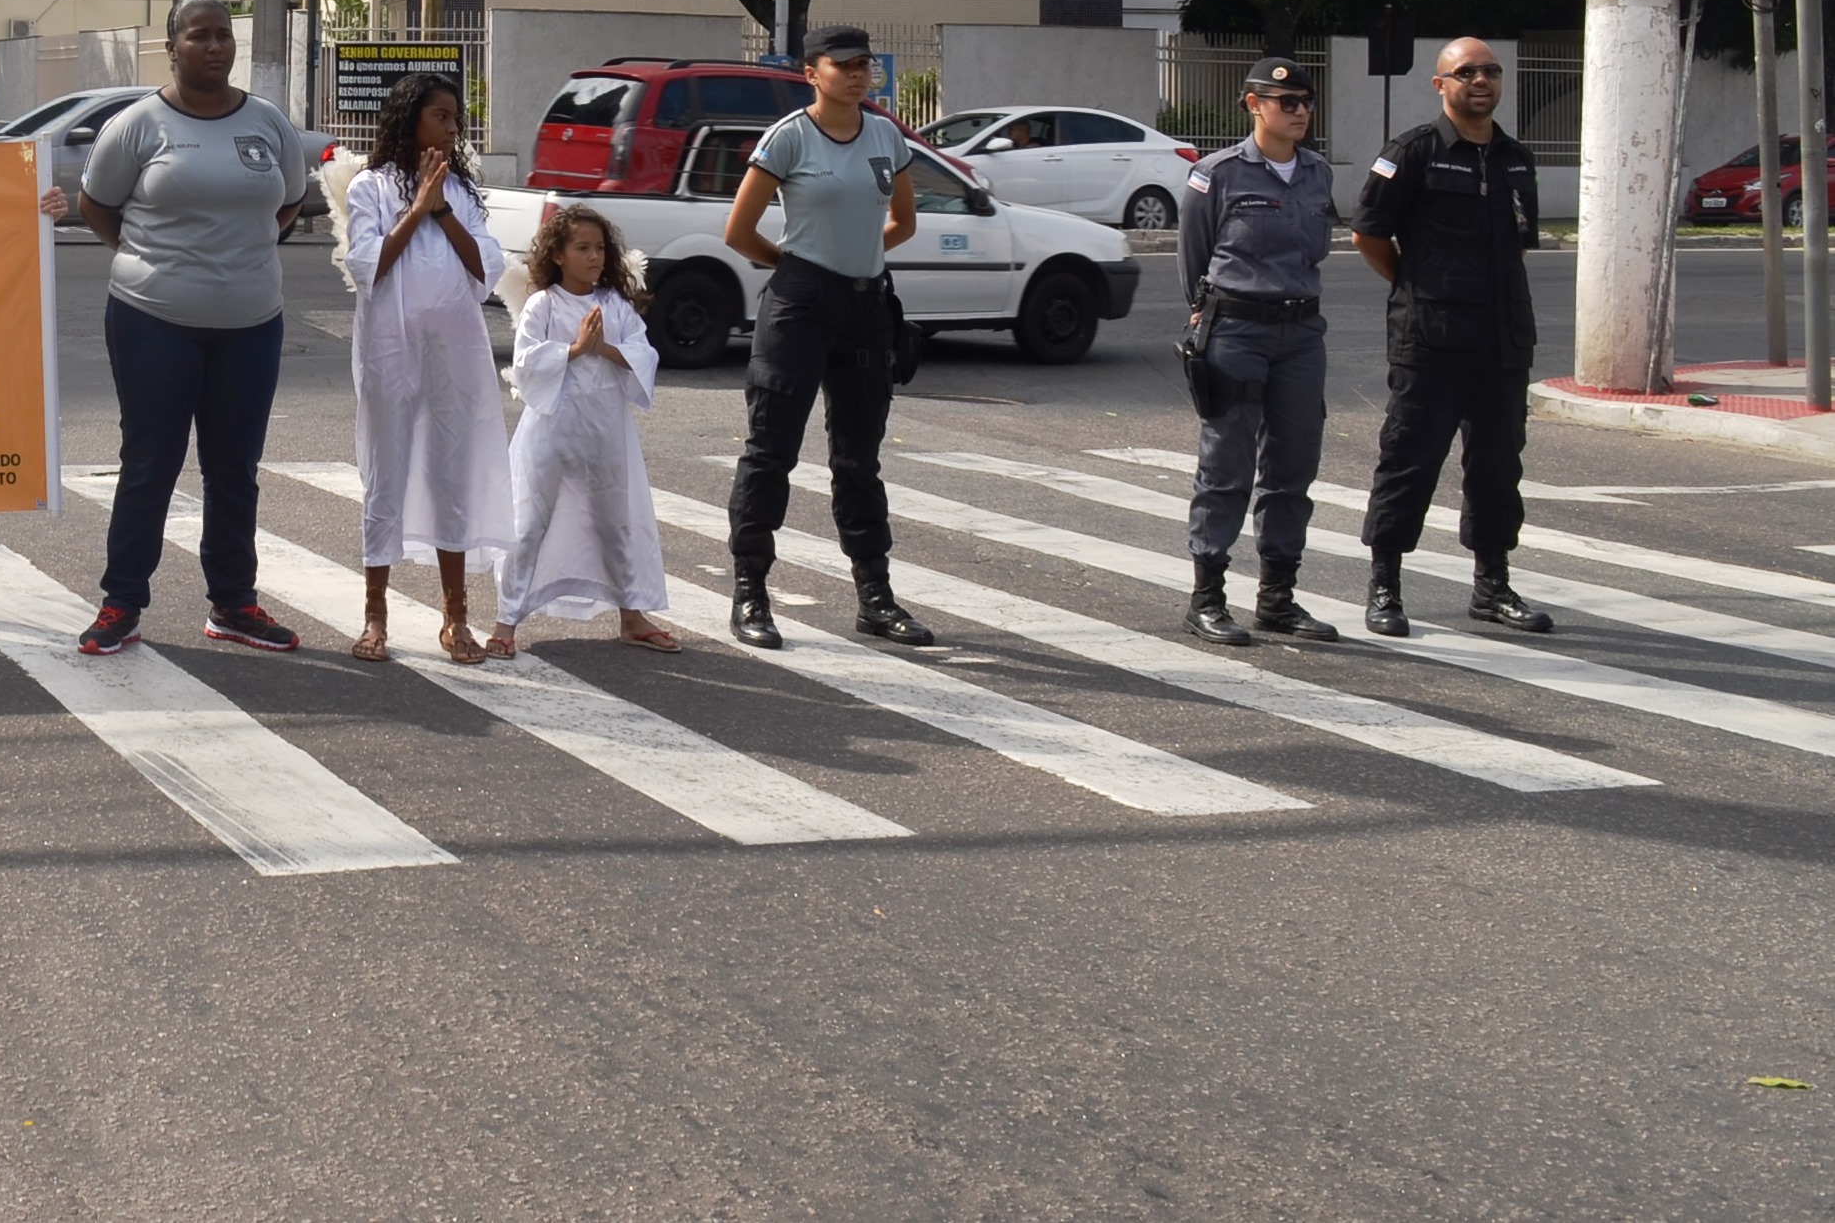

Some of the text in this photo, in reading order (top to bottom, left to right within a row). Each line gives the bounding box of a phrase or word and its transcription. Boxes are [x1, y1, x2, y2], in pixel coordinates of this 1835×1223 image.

[339, 46, 459, 59] SENHOR GOVERNADOR
[338, 60, 460, 72] Não queremos AUMENTO.
[338, 100, 382, 111] SALARIAL!
